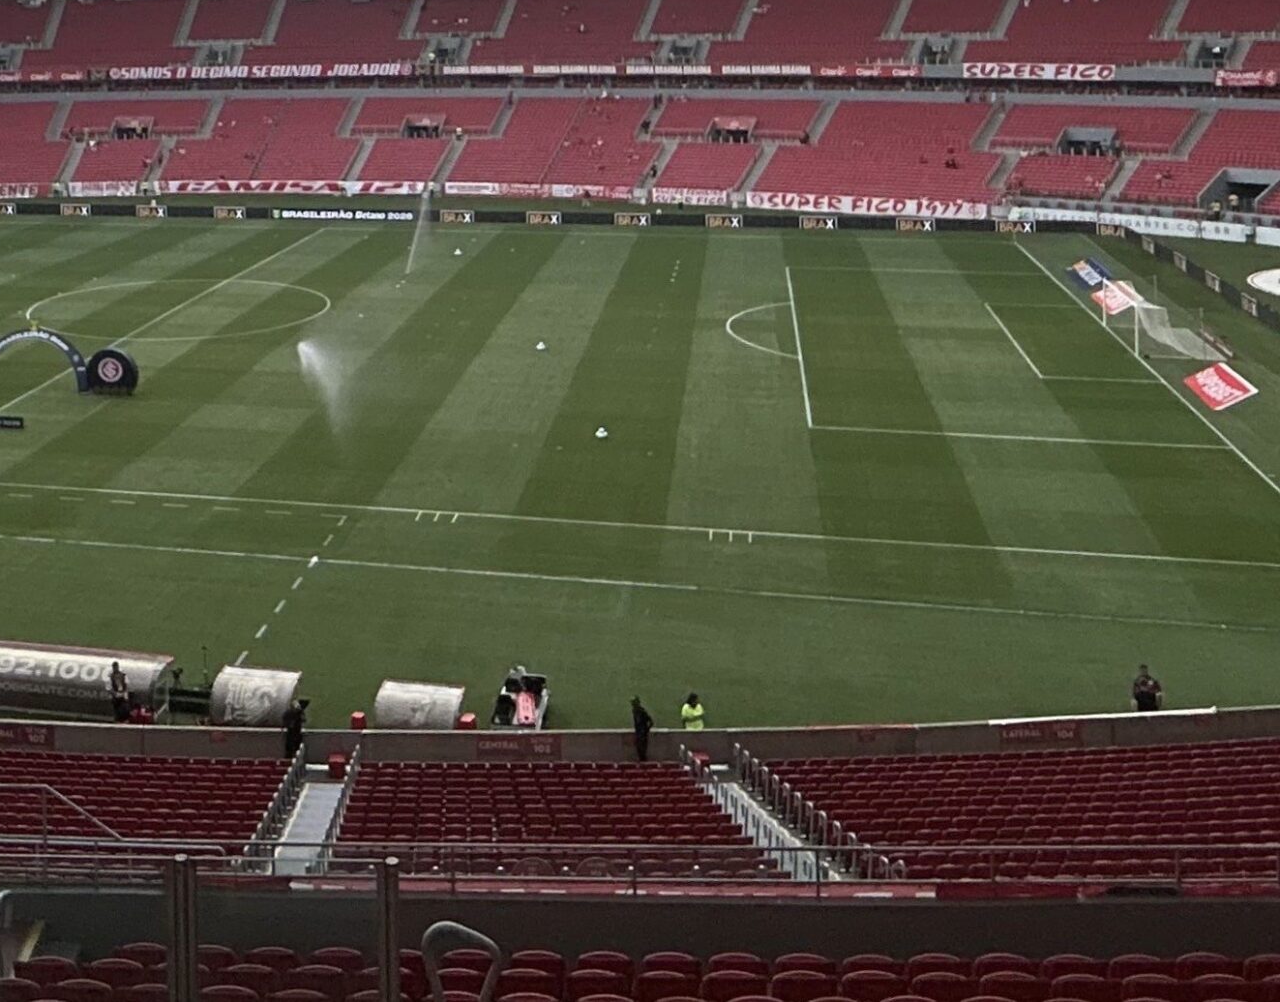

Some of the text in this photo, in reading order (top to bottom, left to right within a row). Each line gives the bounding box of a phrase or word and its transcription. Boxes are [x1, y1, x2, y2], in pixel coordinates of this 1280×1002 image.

[120, 63, 400, 79] SOMOS O DECIMO SEGUNDO JOGADOR
[821, 67, 845, 76] Claro
[855, 68, 880, 76] Claro
[892, 68, 917, 77] Claro
[965, 64, 1114, 79] SUPER FICO
[768, 195, 843, 211] SUPER
[851, 196, 905, 213] FICO
[282, 208, 353, 219] BRASILEIRÃO
[443, 212, 470, 223] BRAX
[529, 214, 558, 225] BRAX
[618, 215, 646, 226] BRAX
[709, 217, 739, 228] BRAX
[802, 219, 834, 229] BRAX
[899, 220, 932, 231] BRAX
[999, 221, 1032, 233] BRAX
[28, 734, 45, 744] 102
[1003, 728, 1042, 739] LATERAL
[478, 741, 519, 750] CENTRAL
